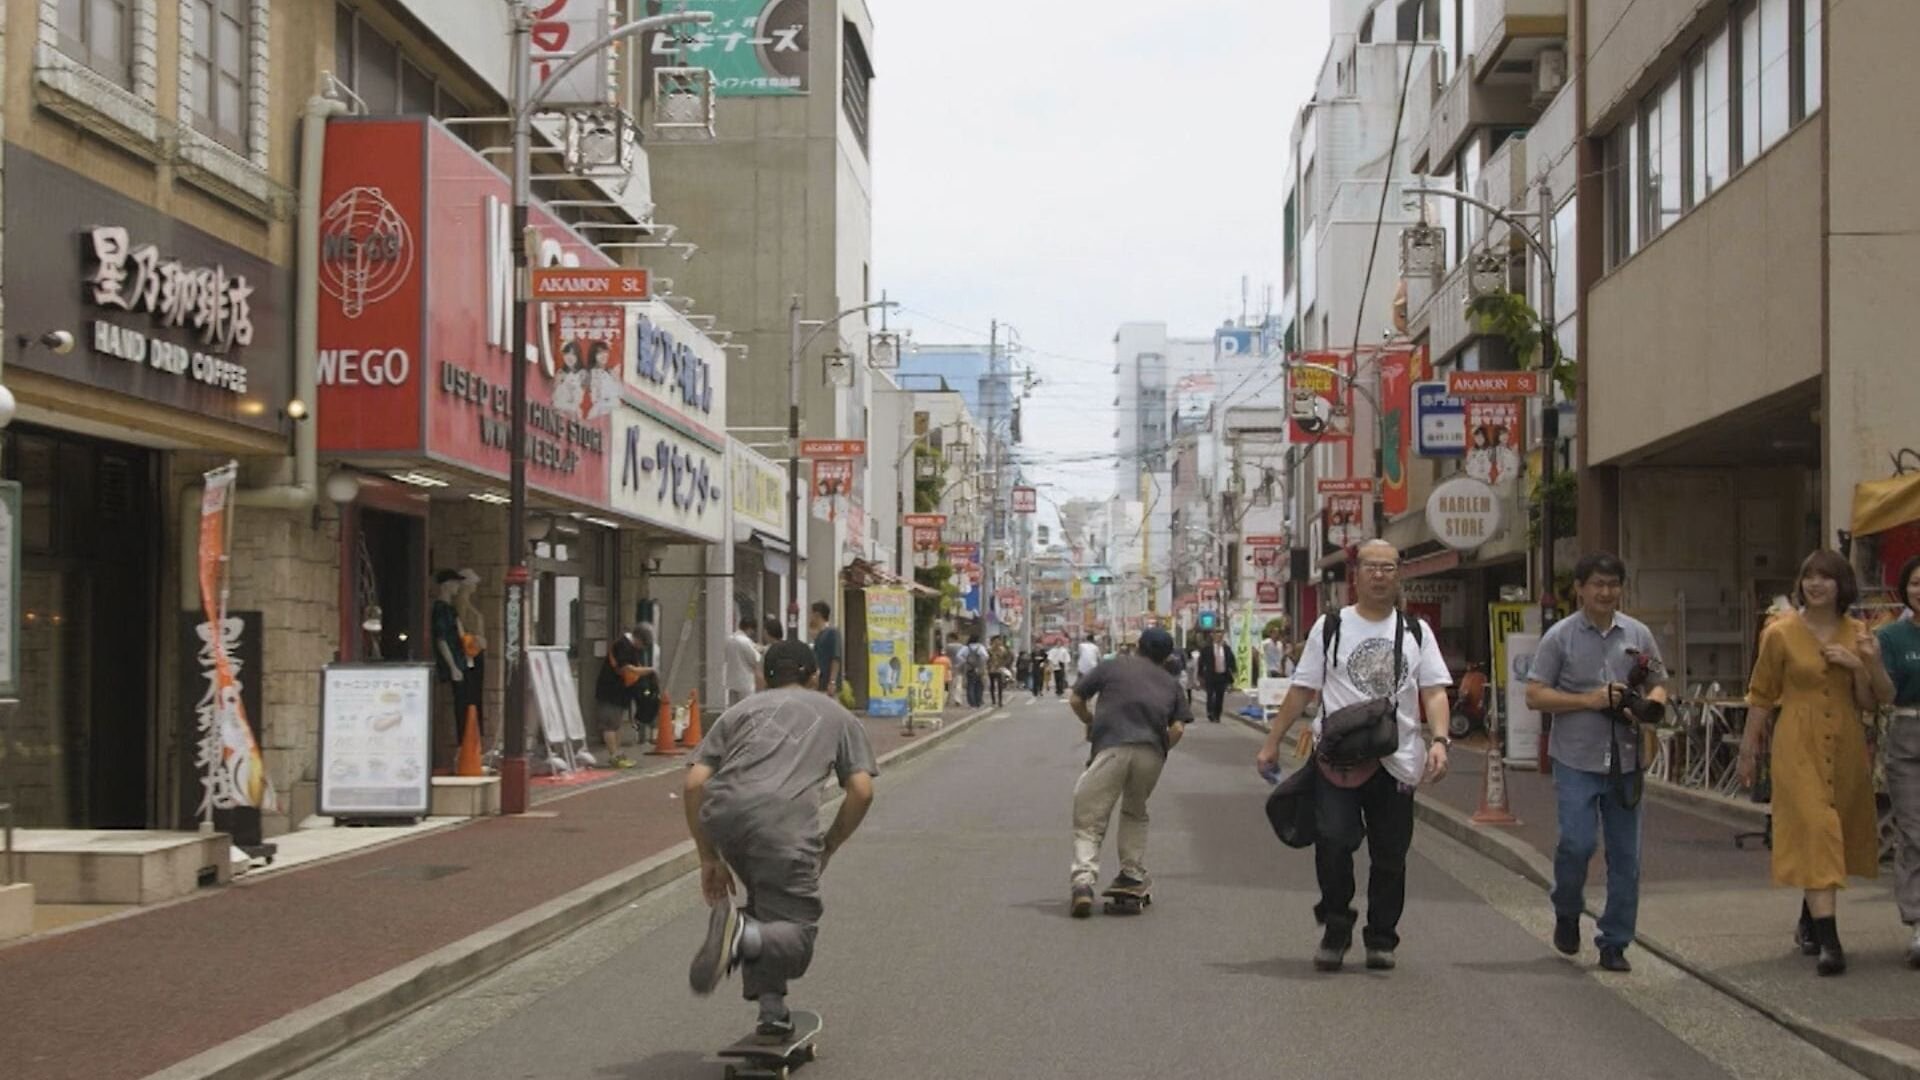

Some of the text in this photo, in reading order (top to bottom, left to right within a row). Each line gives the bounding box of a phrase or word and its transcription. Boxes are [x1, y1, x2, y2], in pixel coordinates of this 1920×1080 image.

[324, 232, 357, 261] WE
[90, 226, 255, 353] 星乃珈琲店
[538, 277, 610, 292] AKAMON
[1220, 335, 1239, 353] P
[94, 321, 248, 394] HAND DRIP COFFEE
[316, 348, 409, 387] WEGO
[1453, 379, 1508, 391] AKAMON
[1438, 496, 1491, 514] HARLEM
[1445, 519, 1485, 537] STORE
